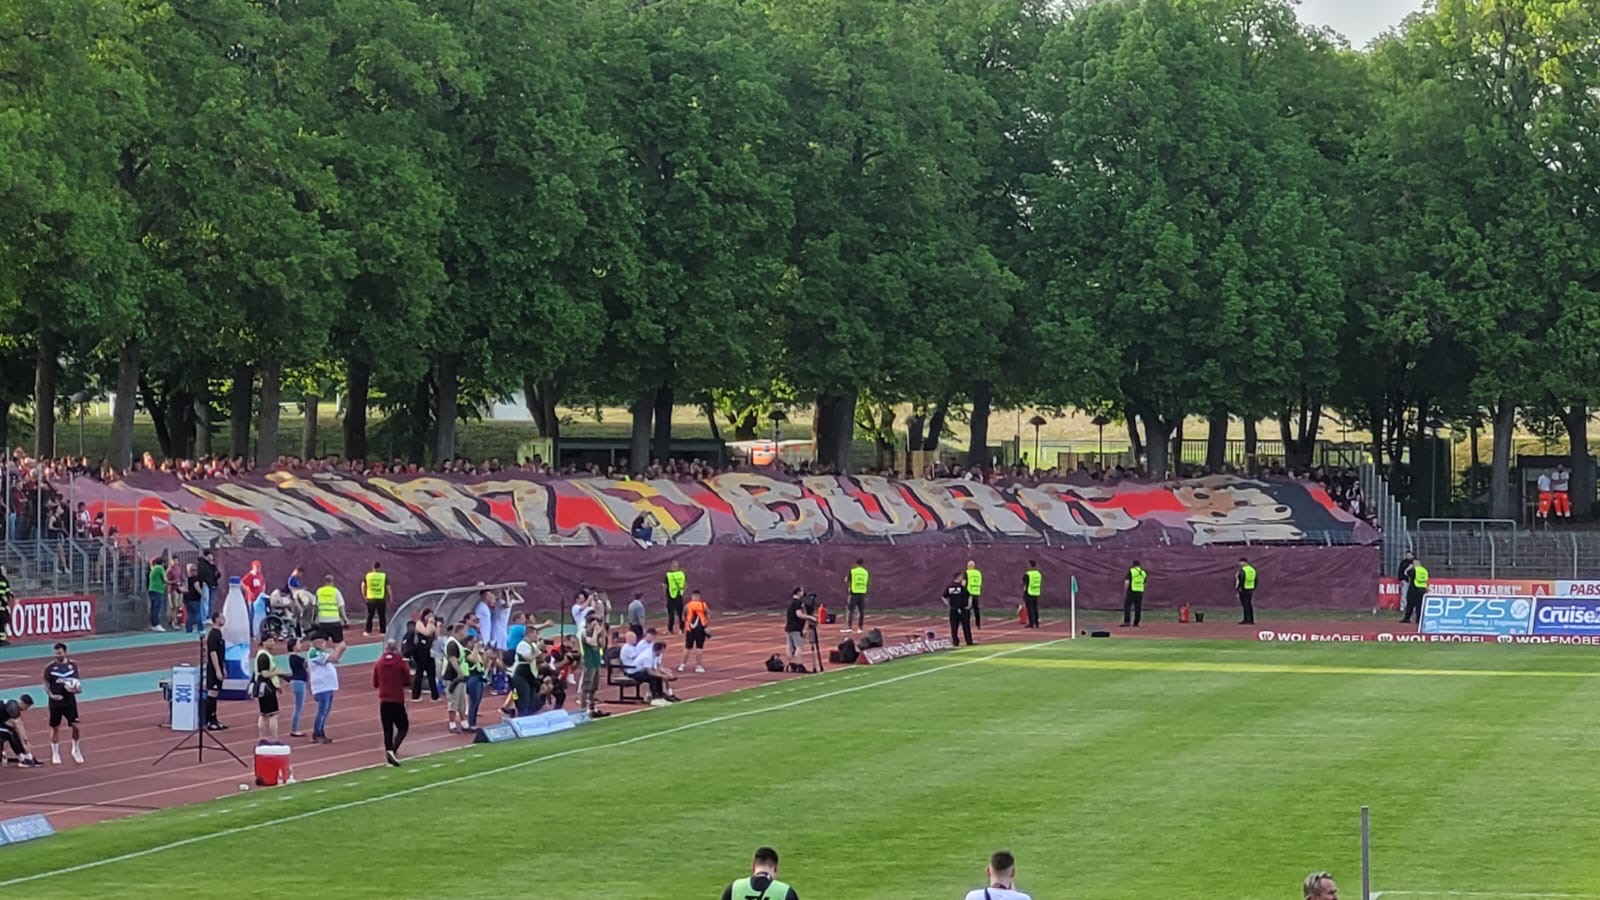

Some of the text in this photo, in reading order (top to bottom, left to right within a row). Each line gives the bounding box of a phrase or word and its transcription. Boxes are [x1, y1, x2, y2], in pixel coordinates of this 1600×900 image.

[1428, 584, 1453, 595] SIND
[1455, 584, 1476, 595] WIR
[51, 600, 92, 633] BIER
[1424, 597, 1507, 618] BPZS
